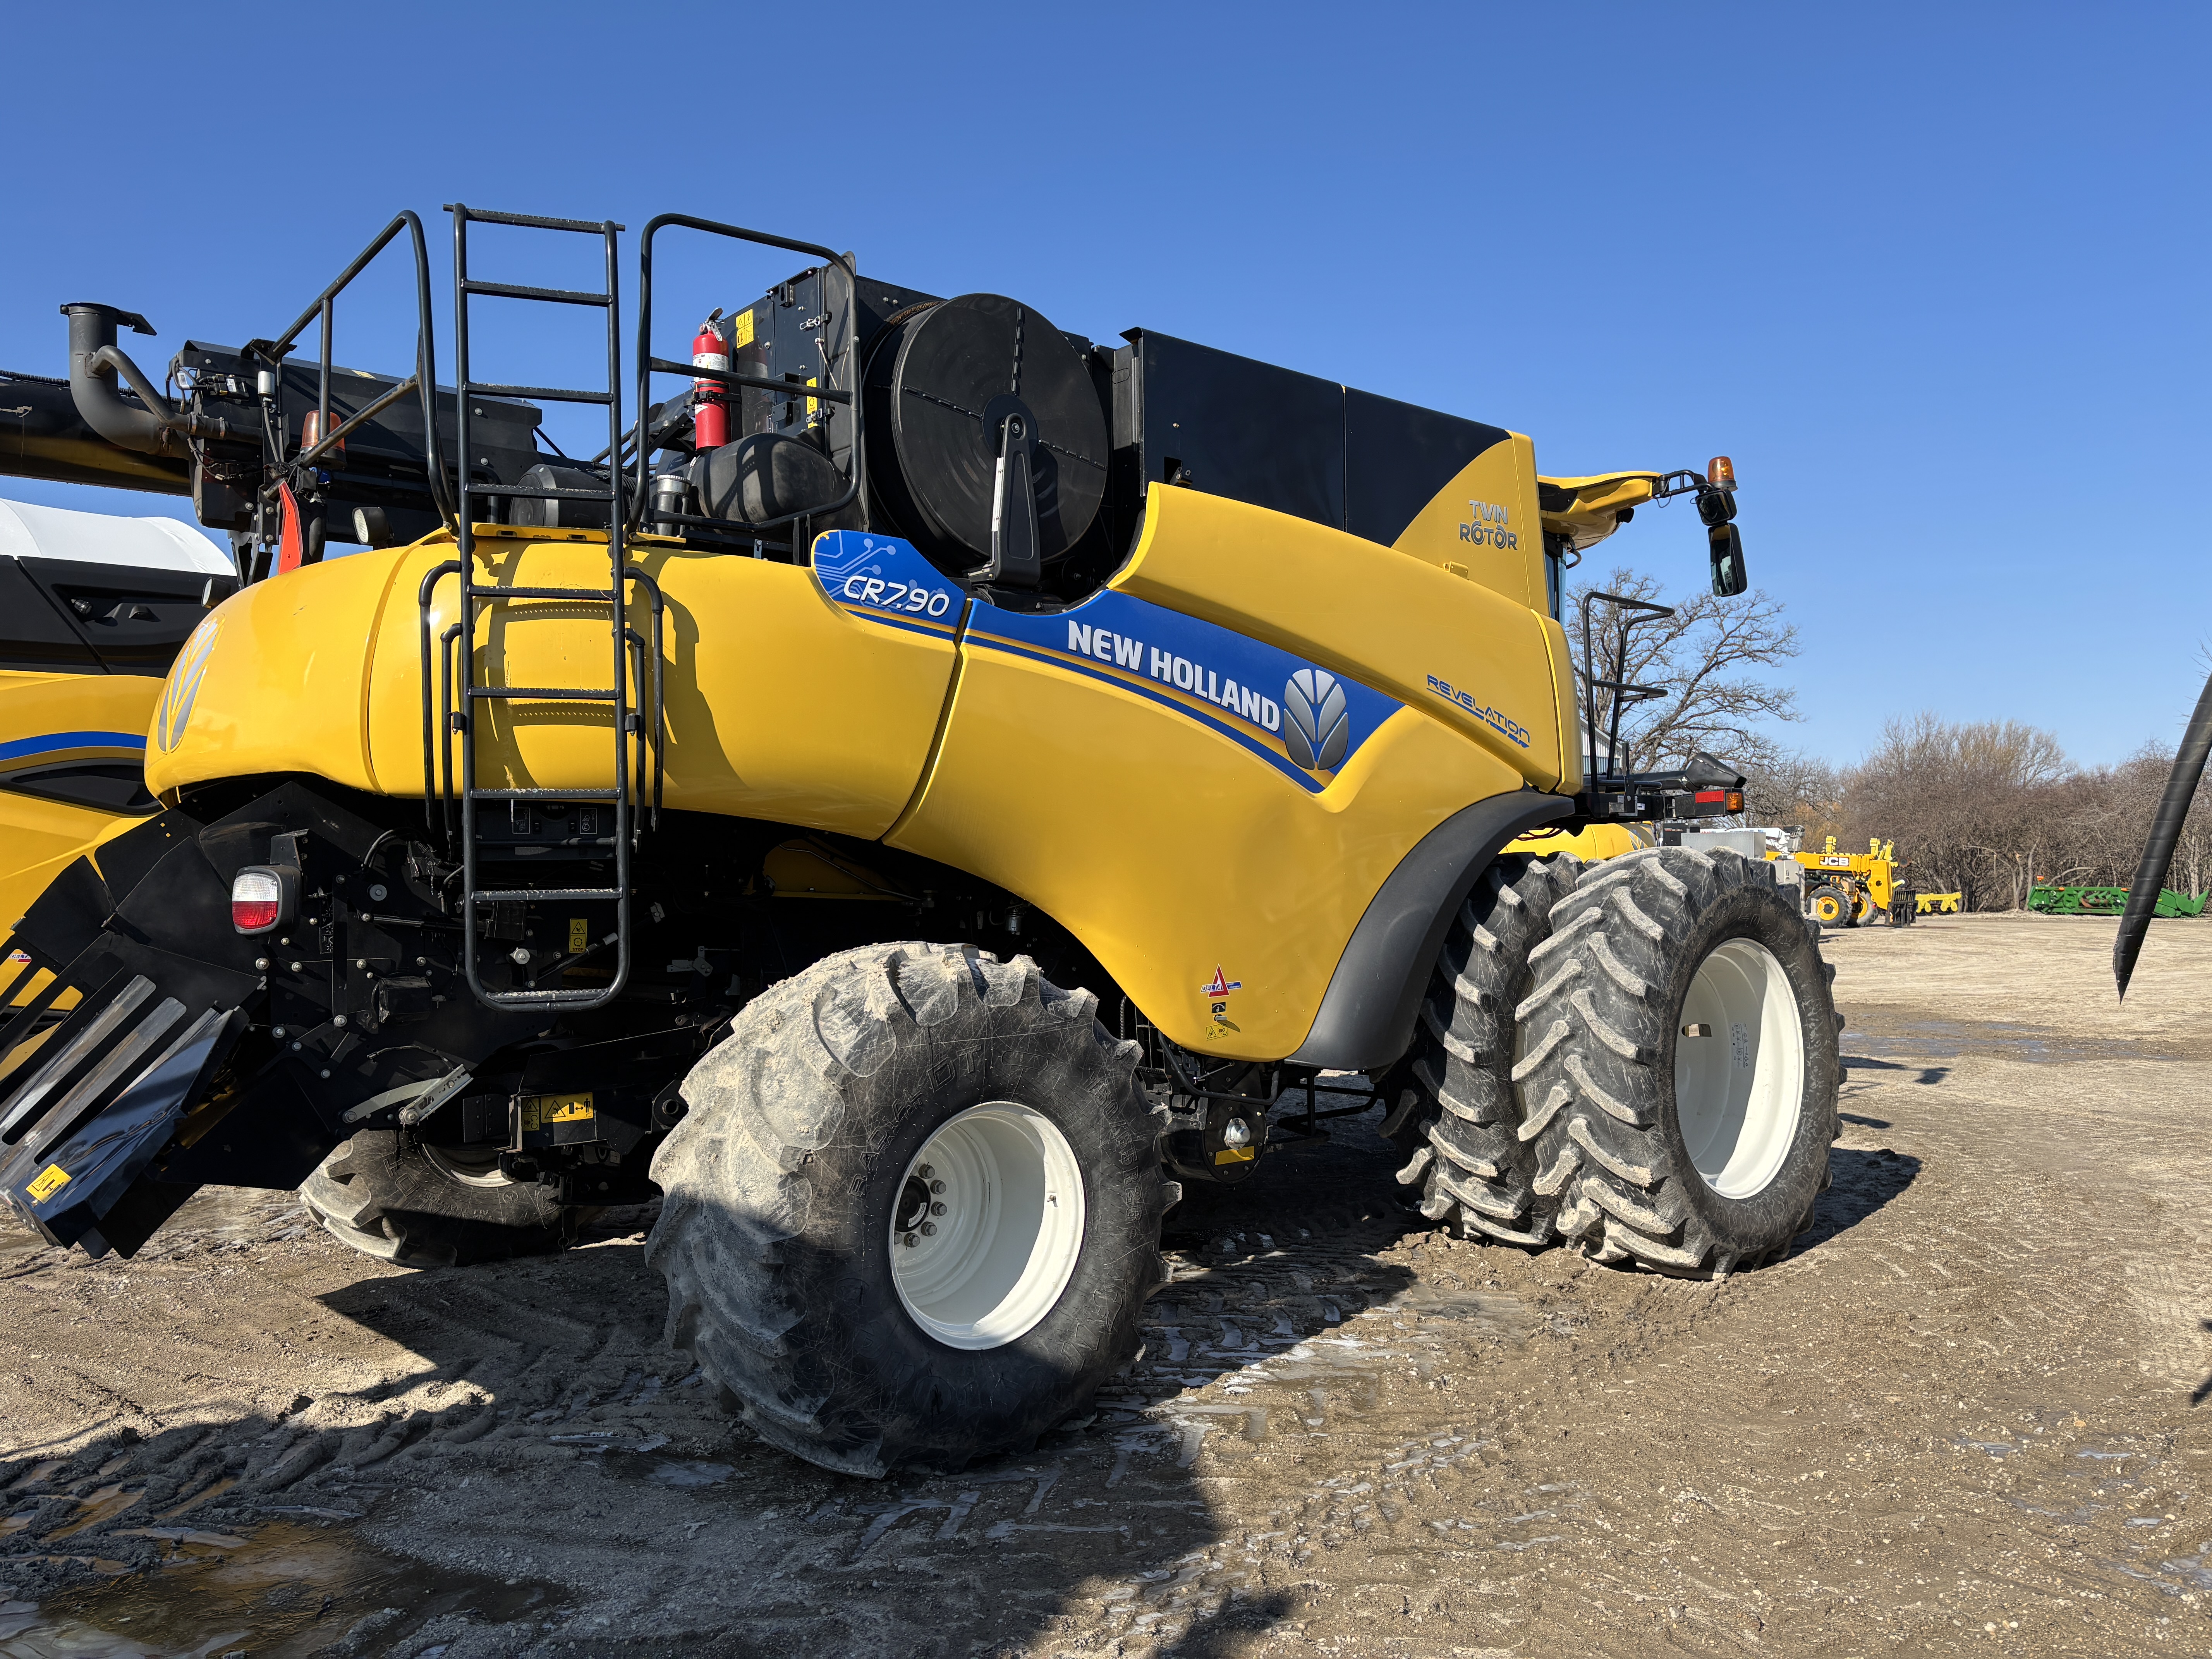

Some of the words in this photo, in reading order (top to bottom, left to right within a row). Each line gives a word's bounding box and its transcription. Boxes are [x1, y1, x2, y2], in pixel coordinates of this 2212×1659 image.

[1469, 499, 1508, 524] TWIN
[1459, 520, 1518, 550] ROTOR
[844, 575, 950, 616] CR7.90
[1068, 620, 1143, 672] NEW
[1151, 646, 1280, 732] HOLLAND
[1820, 856, 1849, 866] JCB
[848, 1089, 924, 1197] RADIAL
[924, 1044, 984, 1094] DT
